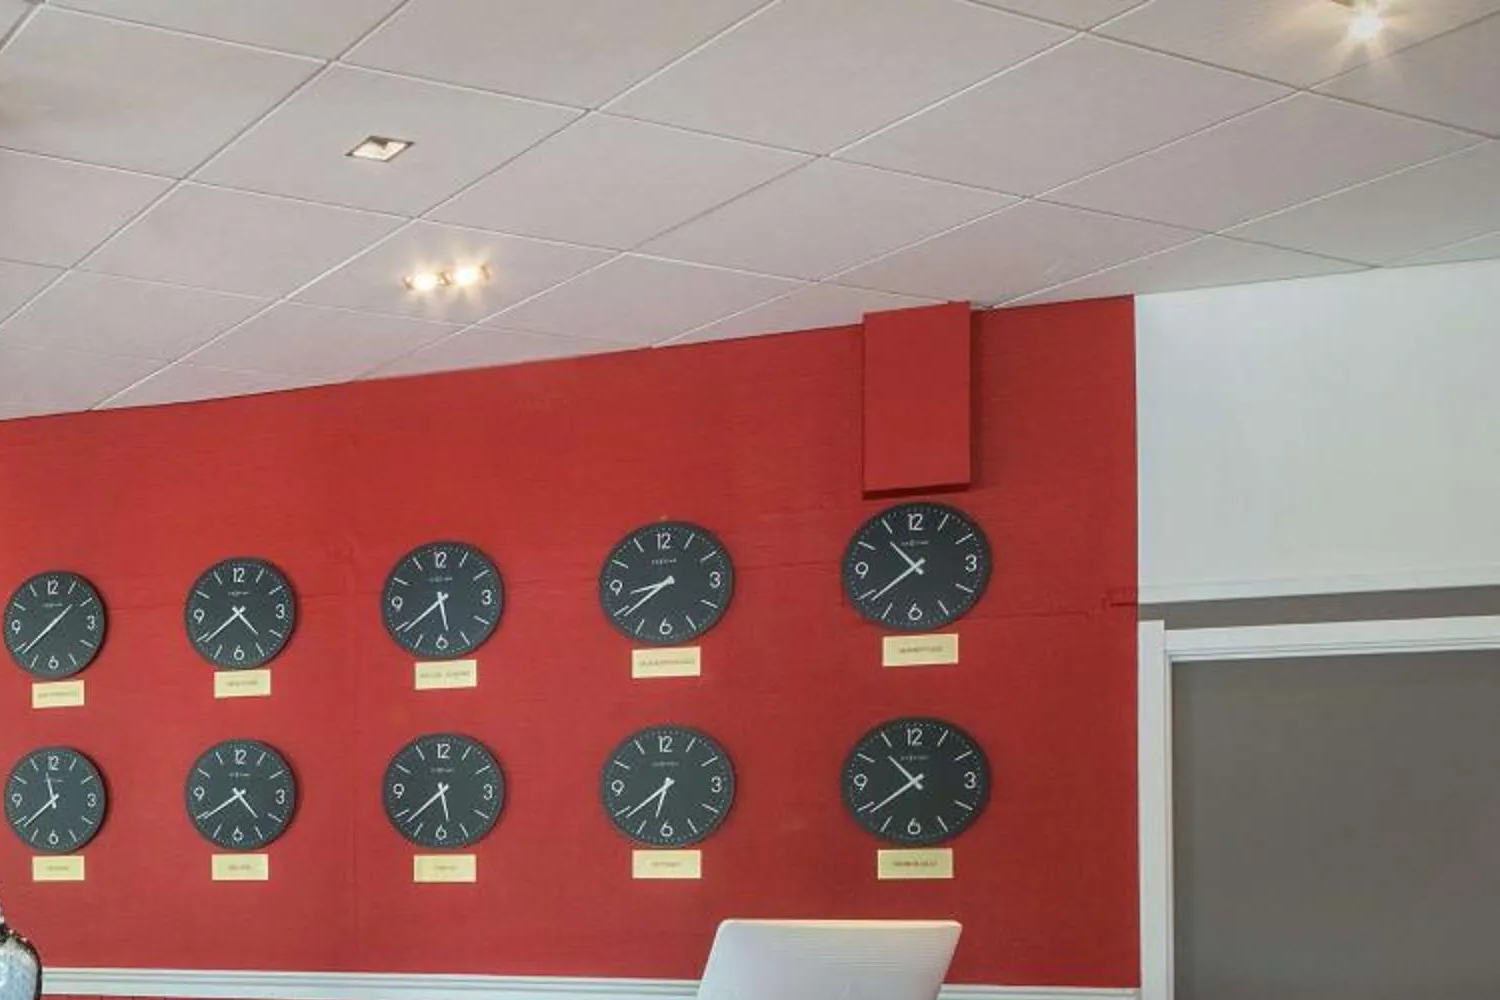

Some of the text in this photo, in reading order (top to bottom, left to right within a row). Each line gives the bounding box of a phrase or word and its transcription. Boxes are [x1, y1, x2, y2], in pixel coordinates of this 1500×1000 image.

[907, 513, 924, 532] 12
[656, 531, 672, 550] 12
[433, 551, 447, 569] 12
[965, 553, 977, 573] 3
[233, 567, 245, 583] 12
[854, 561, 869, 579] 9
[47, 579, 59, 596] 12
[609, 578, 623, 596] 9
[709, 571, 721, 589] 3
[391, 595, 404, 612] 9
[481, 589, 493, 606] 3
[193, 607, 205, 624] 9
[275, 603, 286, 620] 3
[907, 603, 923, 621] 6
[11, 619, 21, 635] 9
[86, 615, 96, 631] 3
[659, 617, 673, 636] 6
[435, 634, 449, 651] 6
[233, 644, 245, 661] 6
[47, 655, 59, 670] 6
[658, 735, 673, 753] 12
[906, 727, 923, 747] 12
[233, 748, 247, 765] 12
[436, 743, 451, 760] 12
[47, 755, 60, 771] 12
[611, 779, 625, 797] 9
[710, 775, 723, 794] 3
[853, 773, 869, 791] 9
[963, 771, 977, 790] 3
[193, 785, 205, 802] 9
[275, 788, 286, 805] 3
[392, 783, 405, 799] 9
[483, 783, 493, 801] 3
[11, 792, 23, 809] 9
[87, 792, 97, 809] 3
[231, 826, 245, 843] 6
[435, 824, 448, 841] 6
[659, 821, 674, 838] 6
[907, 817, 922, 836] 6
[48, 829, 59, 845] 6
